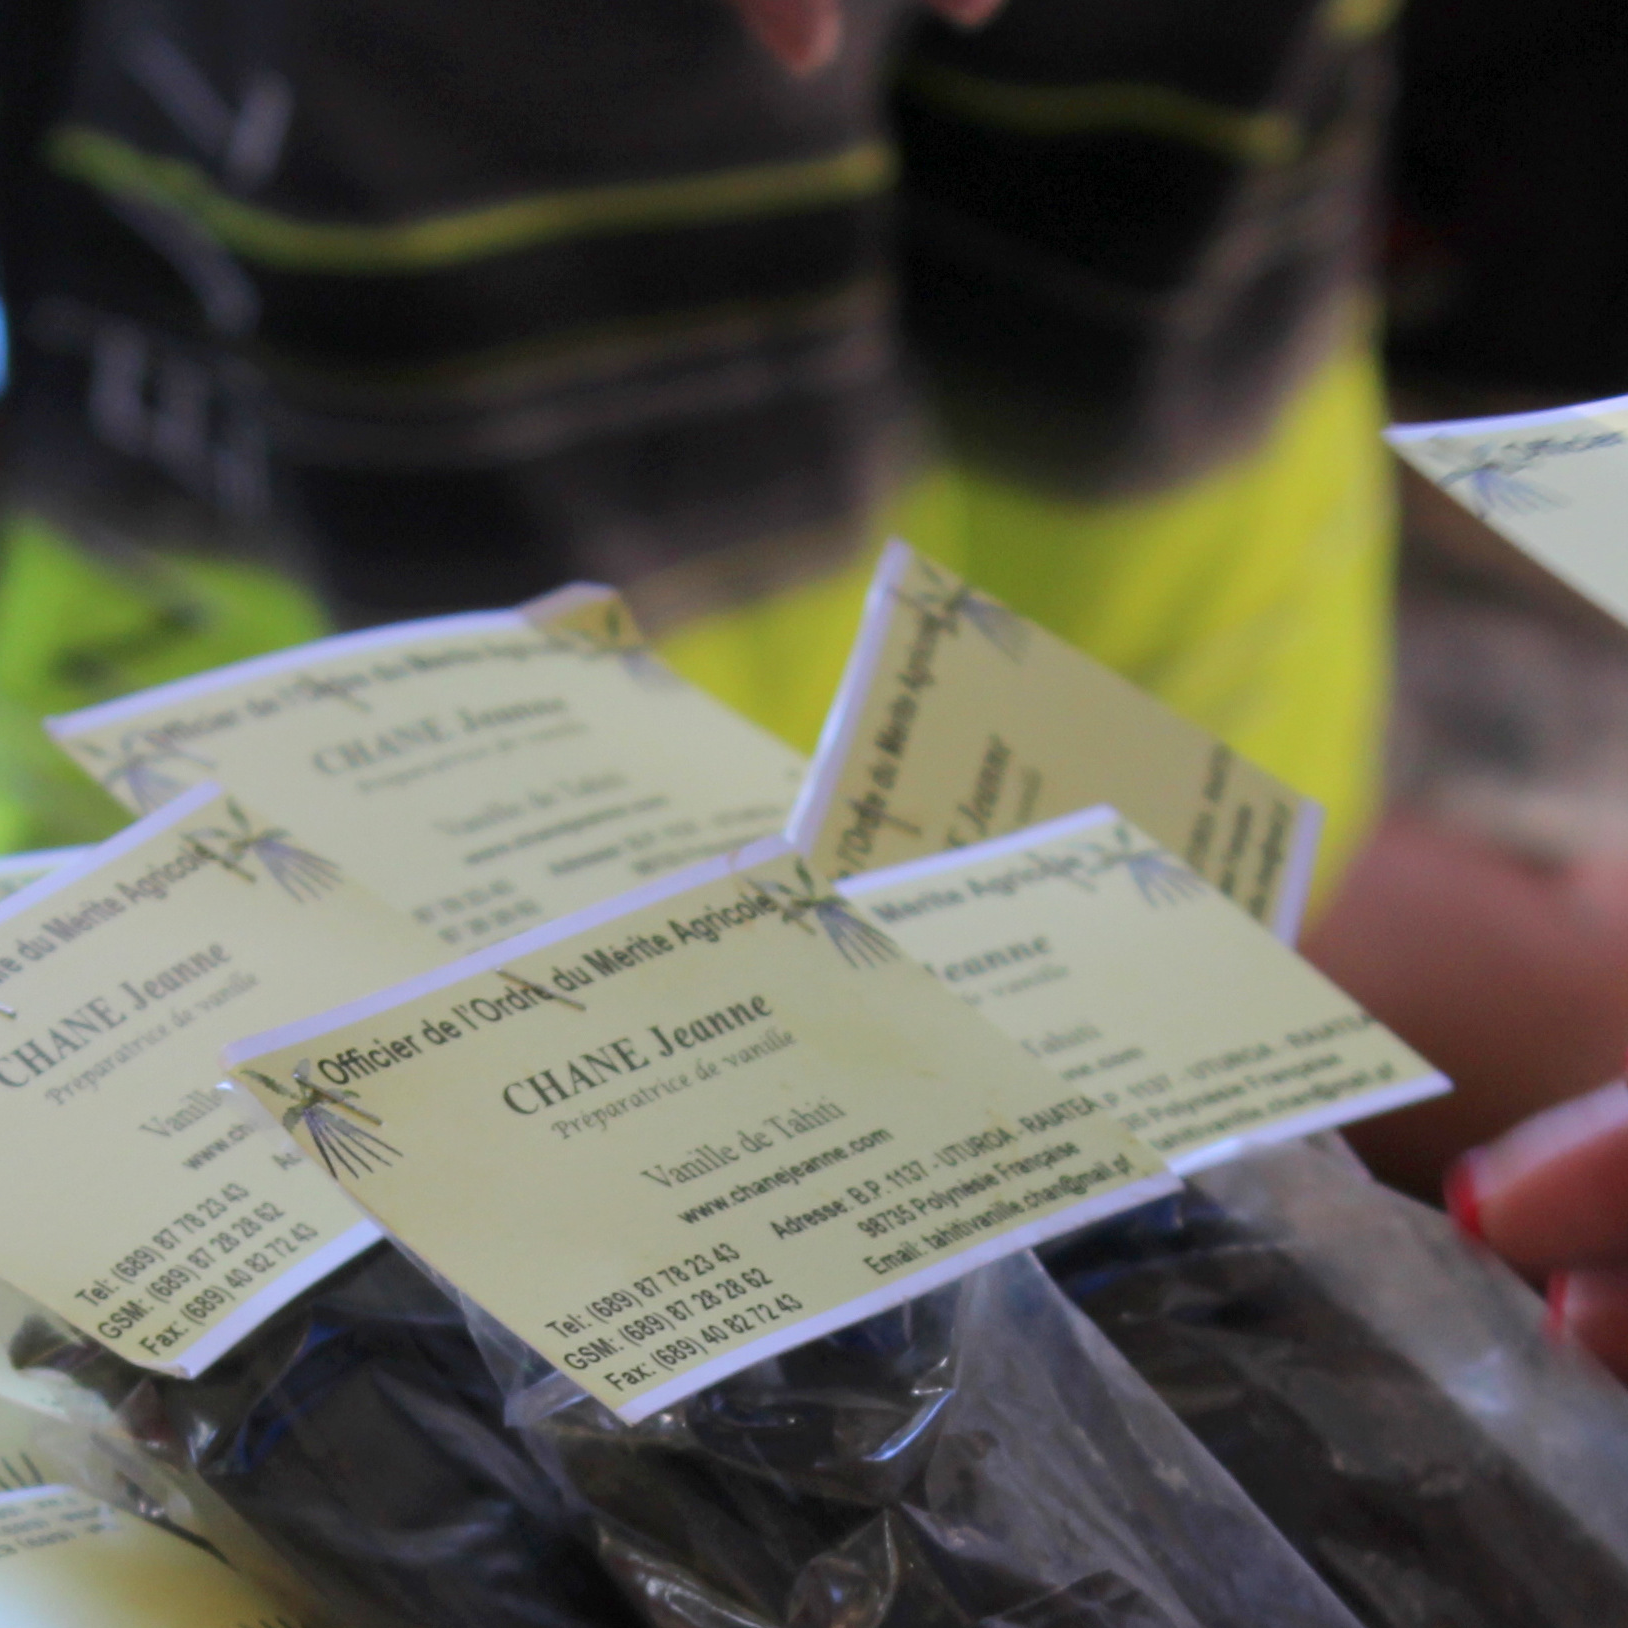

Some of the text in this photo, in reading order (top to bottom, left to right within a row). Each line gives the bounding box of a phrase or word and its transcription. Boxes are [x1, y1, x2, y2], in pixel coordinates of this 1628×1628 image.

[16, 936, 57, 961] du
[117, 942, 232, 1011] Jeanne
[316, 887, 790, 1086] Officier de l'Ordre du Mérite Agricole
[500, 994, 774, 1116] CHANE Jeanne
[693, 1058, 720, 1081] de
[719, 1028, 798, 1068] vanille
[639, 1101, 847, 1188] Vanille de Tahiti
[677, 1128, 894, 1225] www.chanejeanne.com
[767, 1096, 1100, 1240] Adresse: B.P. 1137 UTUROA RAIATEA
[856, 1140, 1081, 1238] 98735 Polynésie Française
[73, 1183, 249, 1307] Tel: (689) 87 78 23 43
[544, 1243, 740, 1339] Tel: (689) 87 78 23 43
[862, 1240, 925, 1275] Email:
[560, 1267, 773, 1373] GSM: (689) 87 28 28 62
